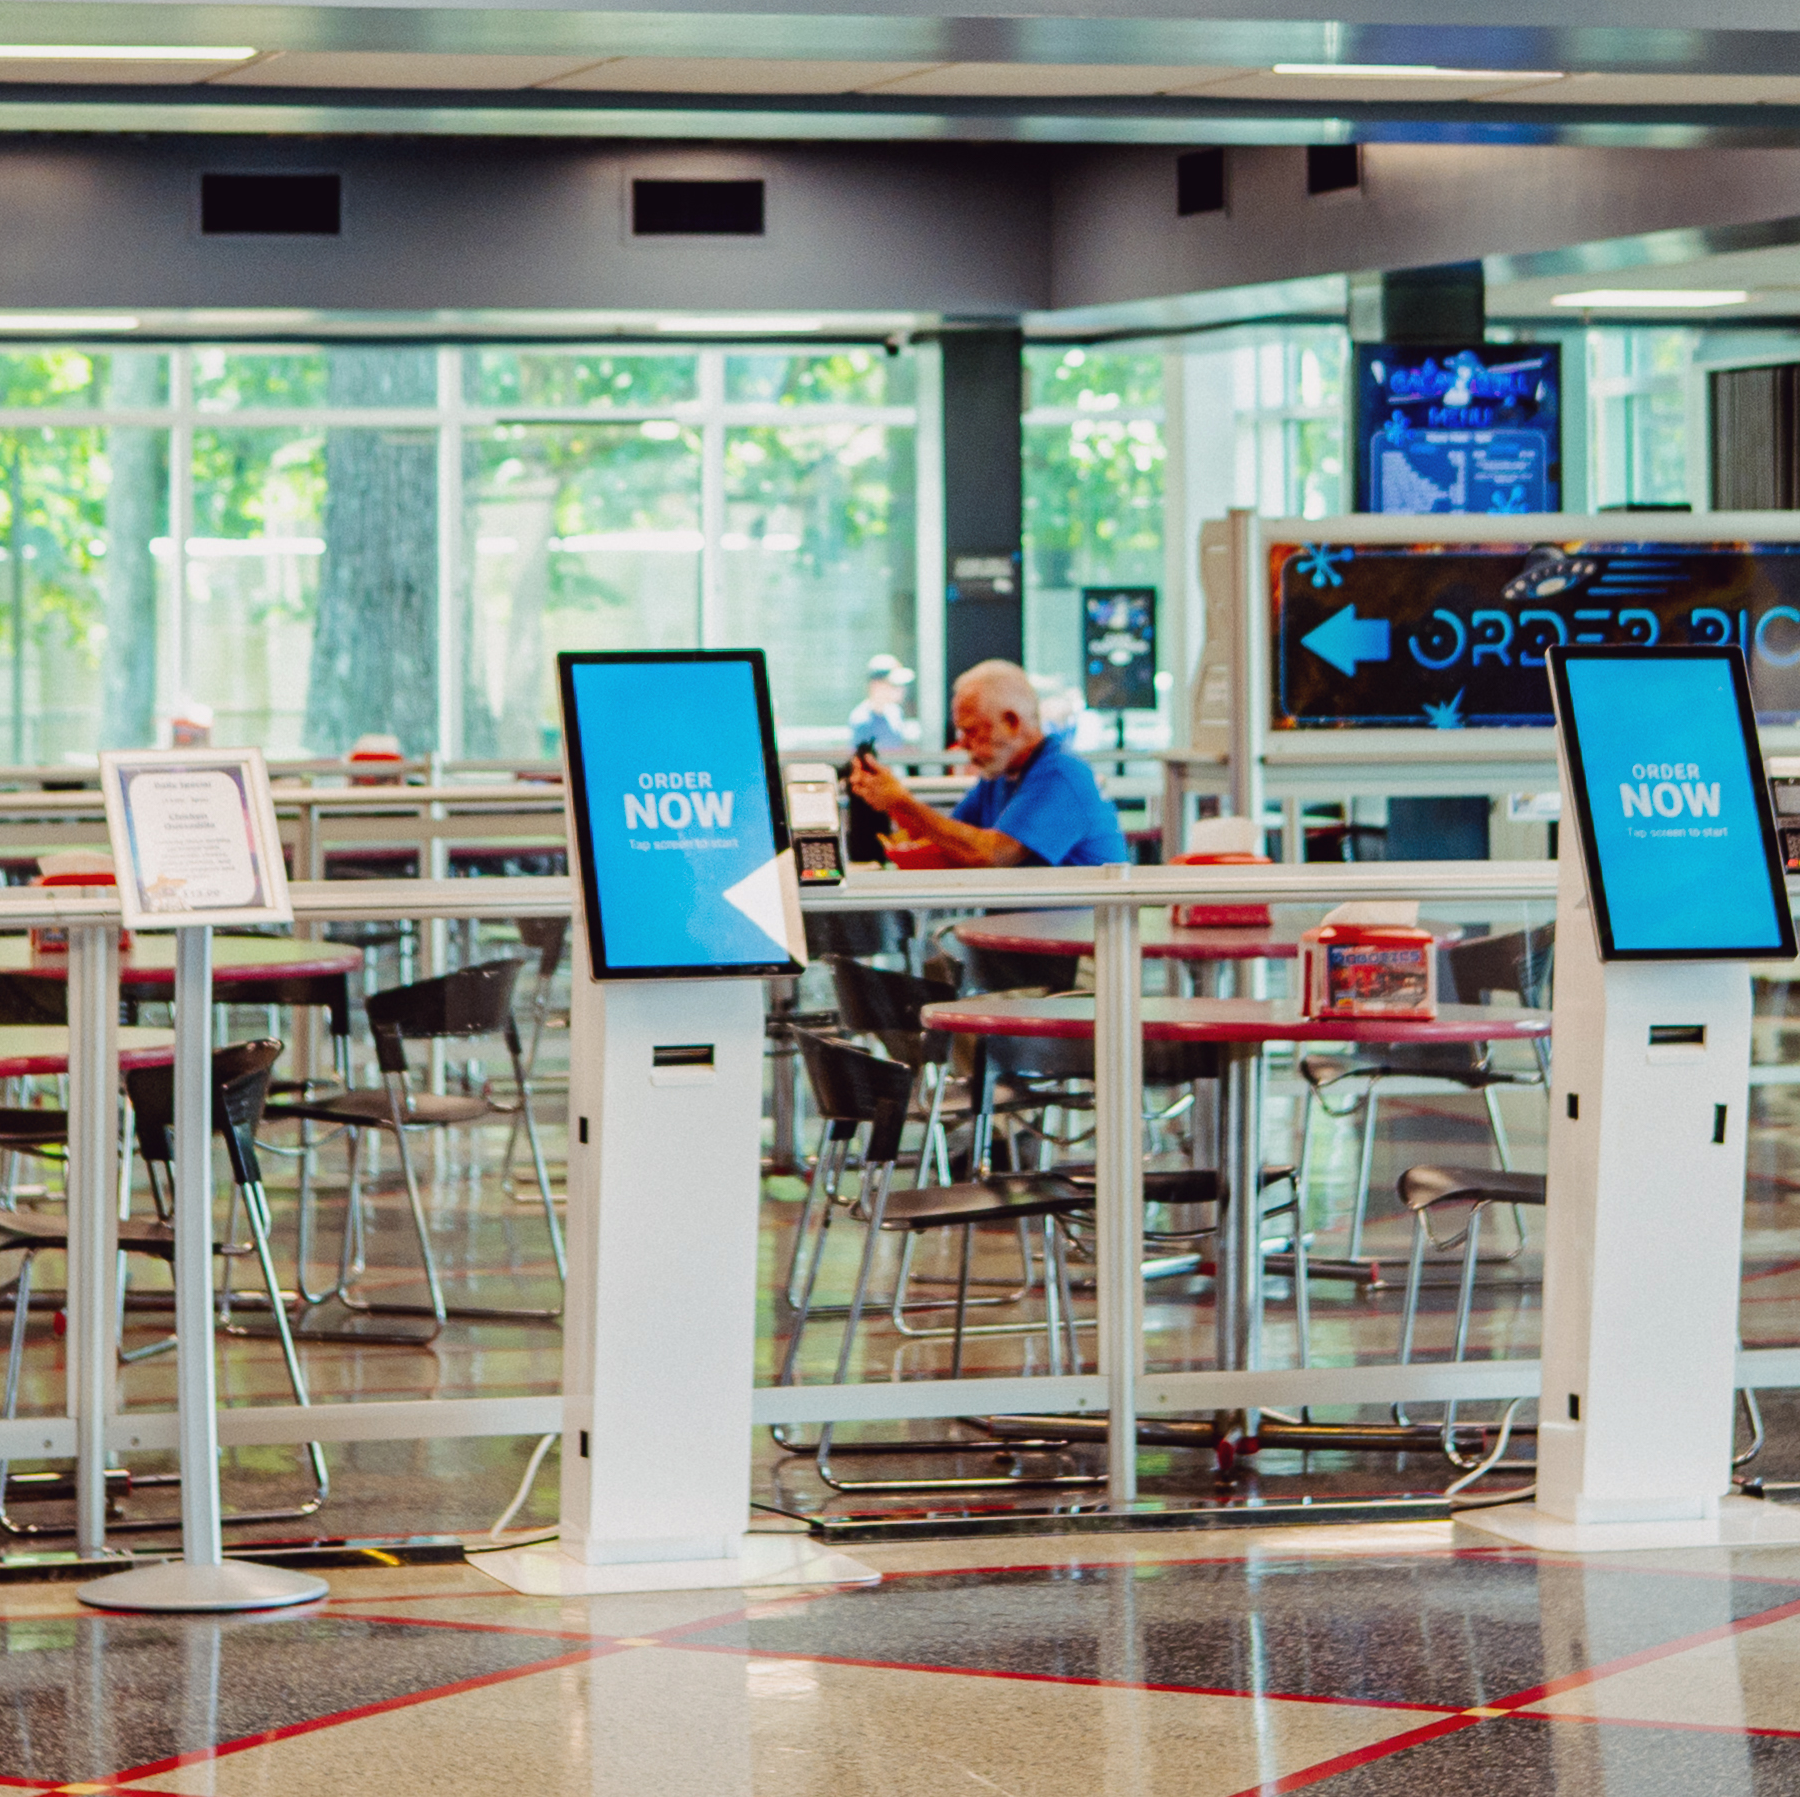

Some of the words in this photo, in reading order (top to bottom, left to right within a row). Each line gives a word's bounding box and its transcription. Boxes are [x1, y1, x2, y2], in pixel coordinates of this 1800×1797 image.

[638, 771, 713, 789] ORDER
[1632, 763, 1701, 780] ORDER
[623, 790, 734, 830] NOW
[1619, 781, 1721, 818] NOW
